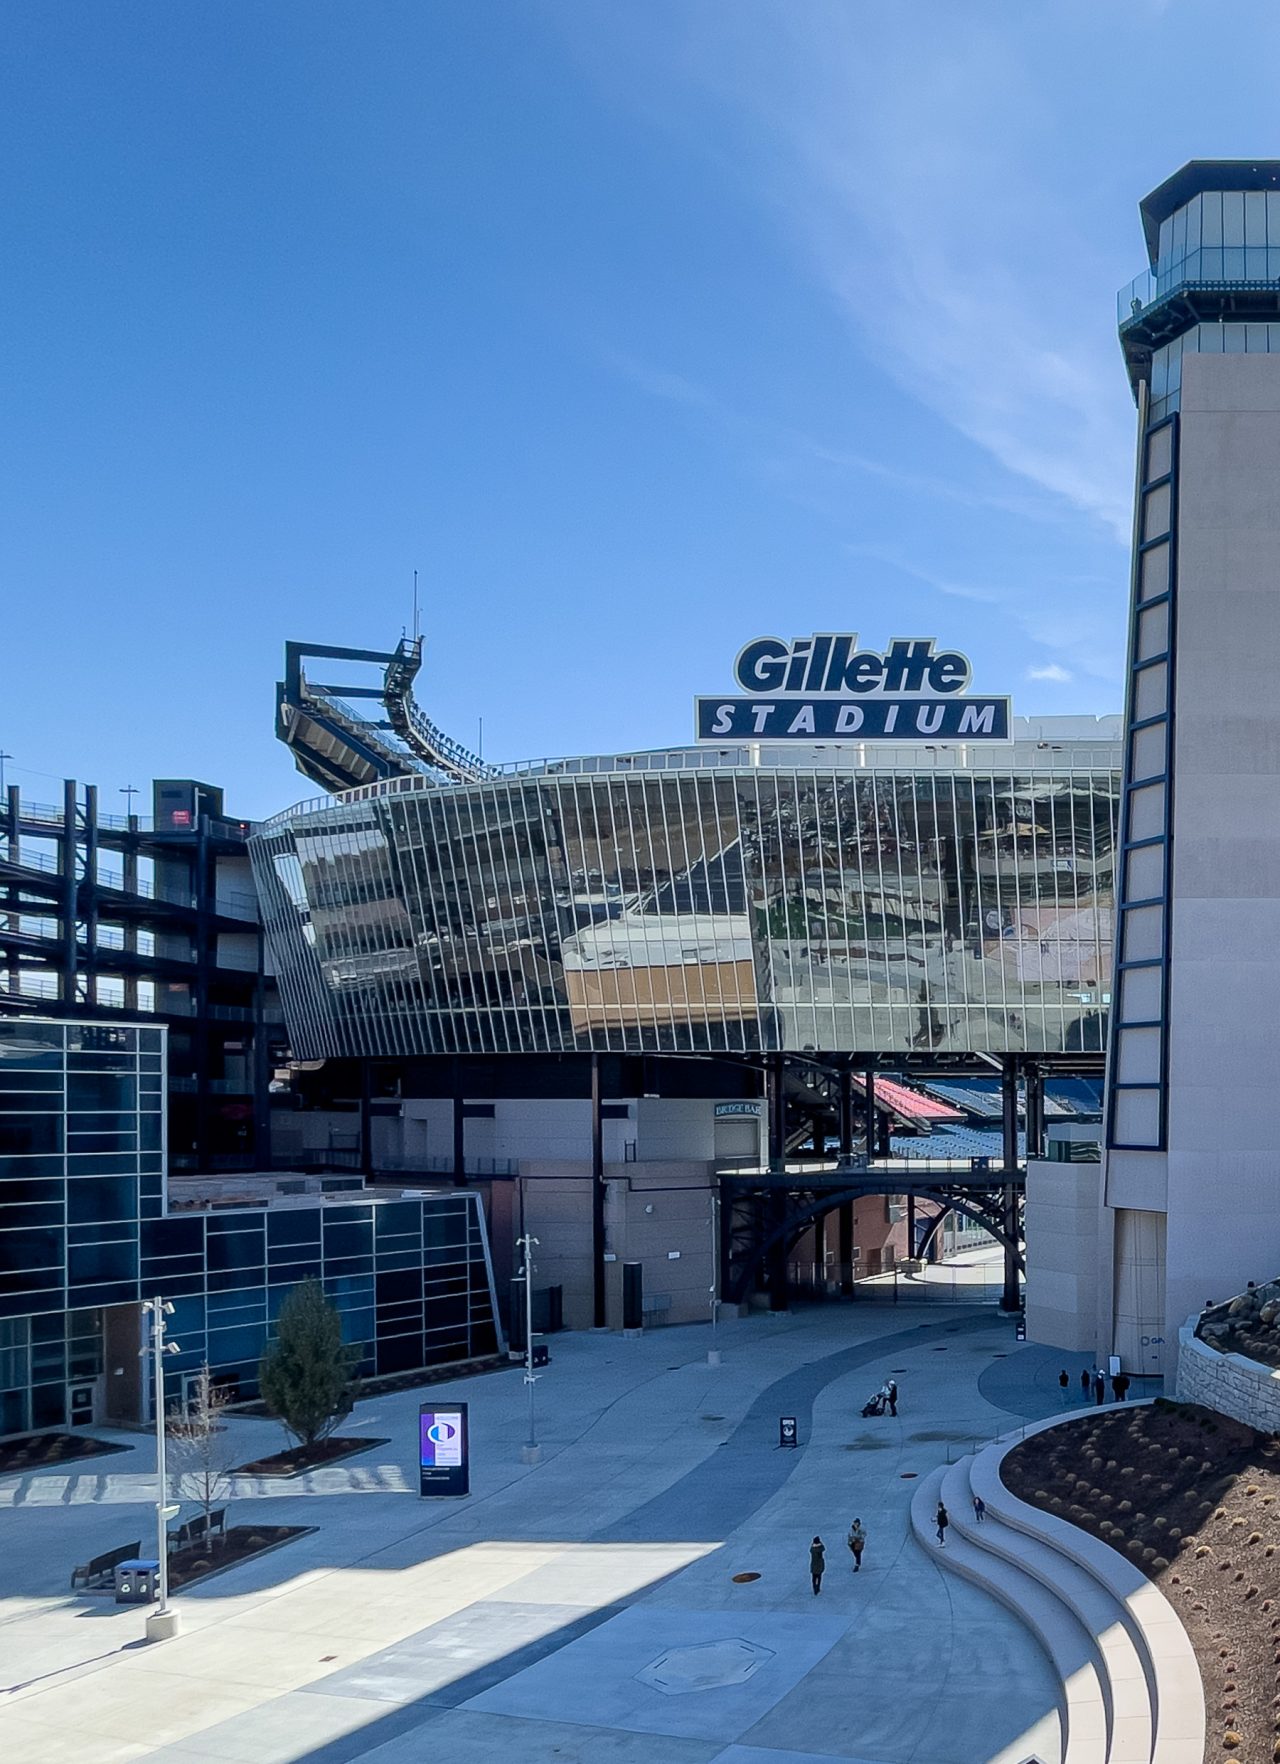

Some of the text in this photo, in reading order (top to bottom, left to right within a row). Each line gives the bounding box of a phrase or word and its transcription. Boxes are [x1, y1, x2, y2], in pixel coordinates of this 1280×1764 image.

[737, 636, 967, 693] Gillette
[711, 704, 995, 734] STADIUM
[716, 1103, 762, 1115] BRIDGE BAR
